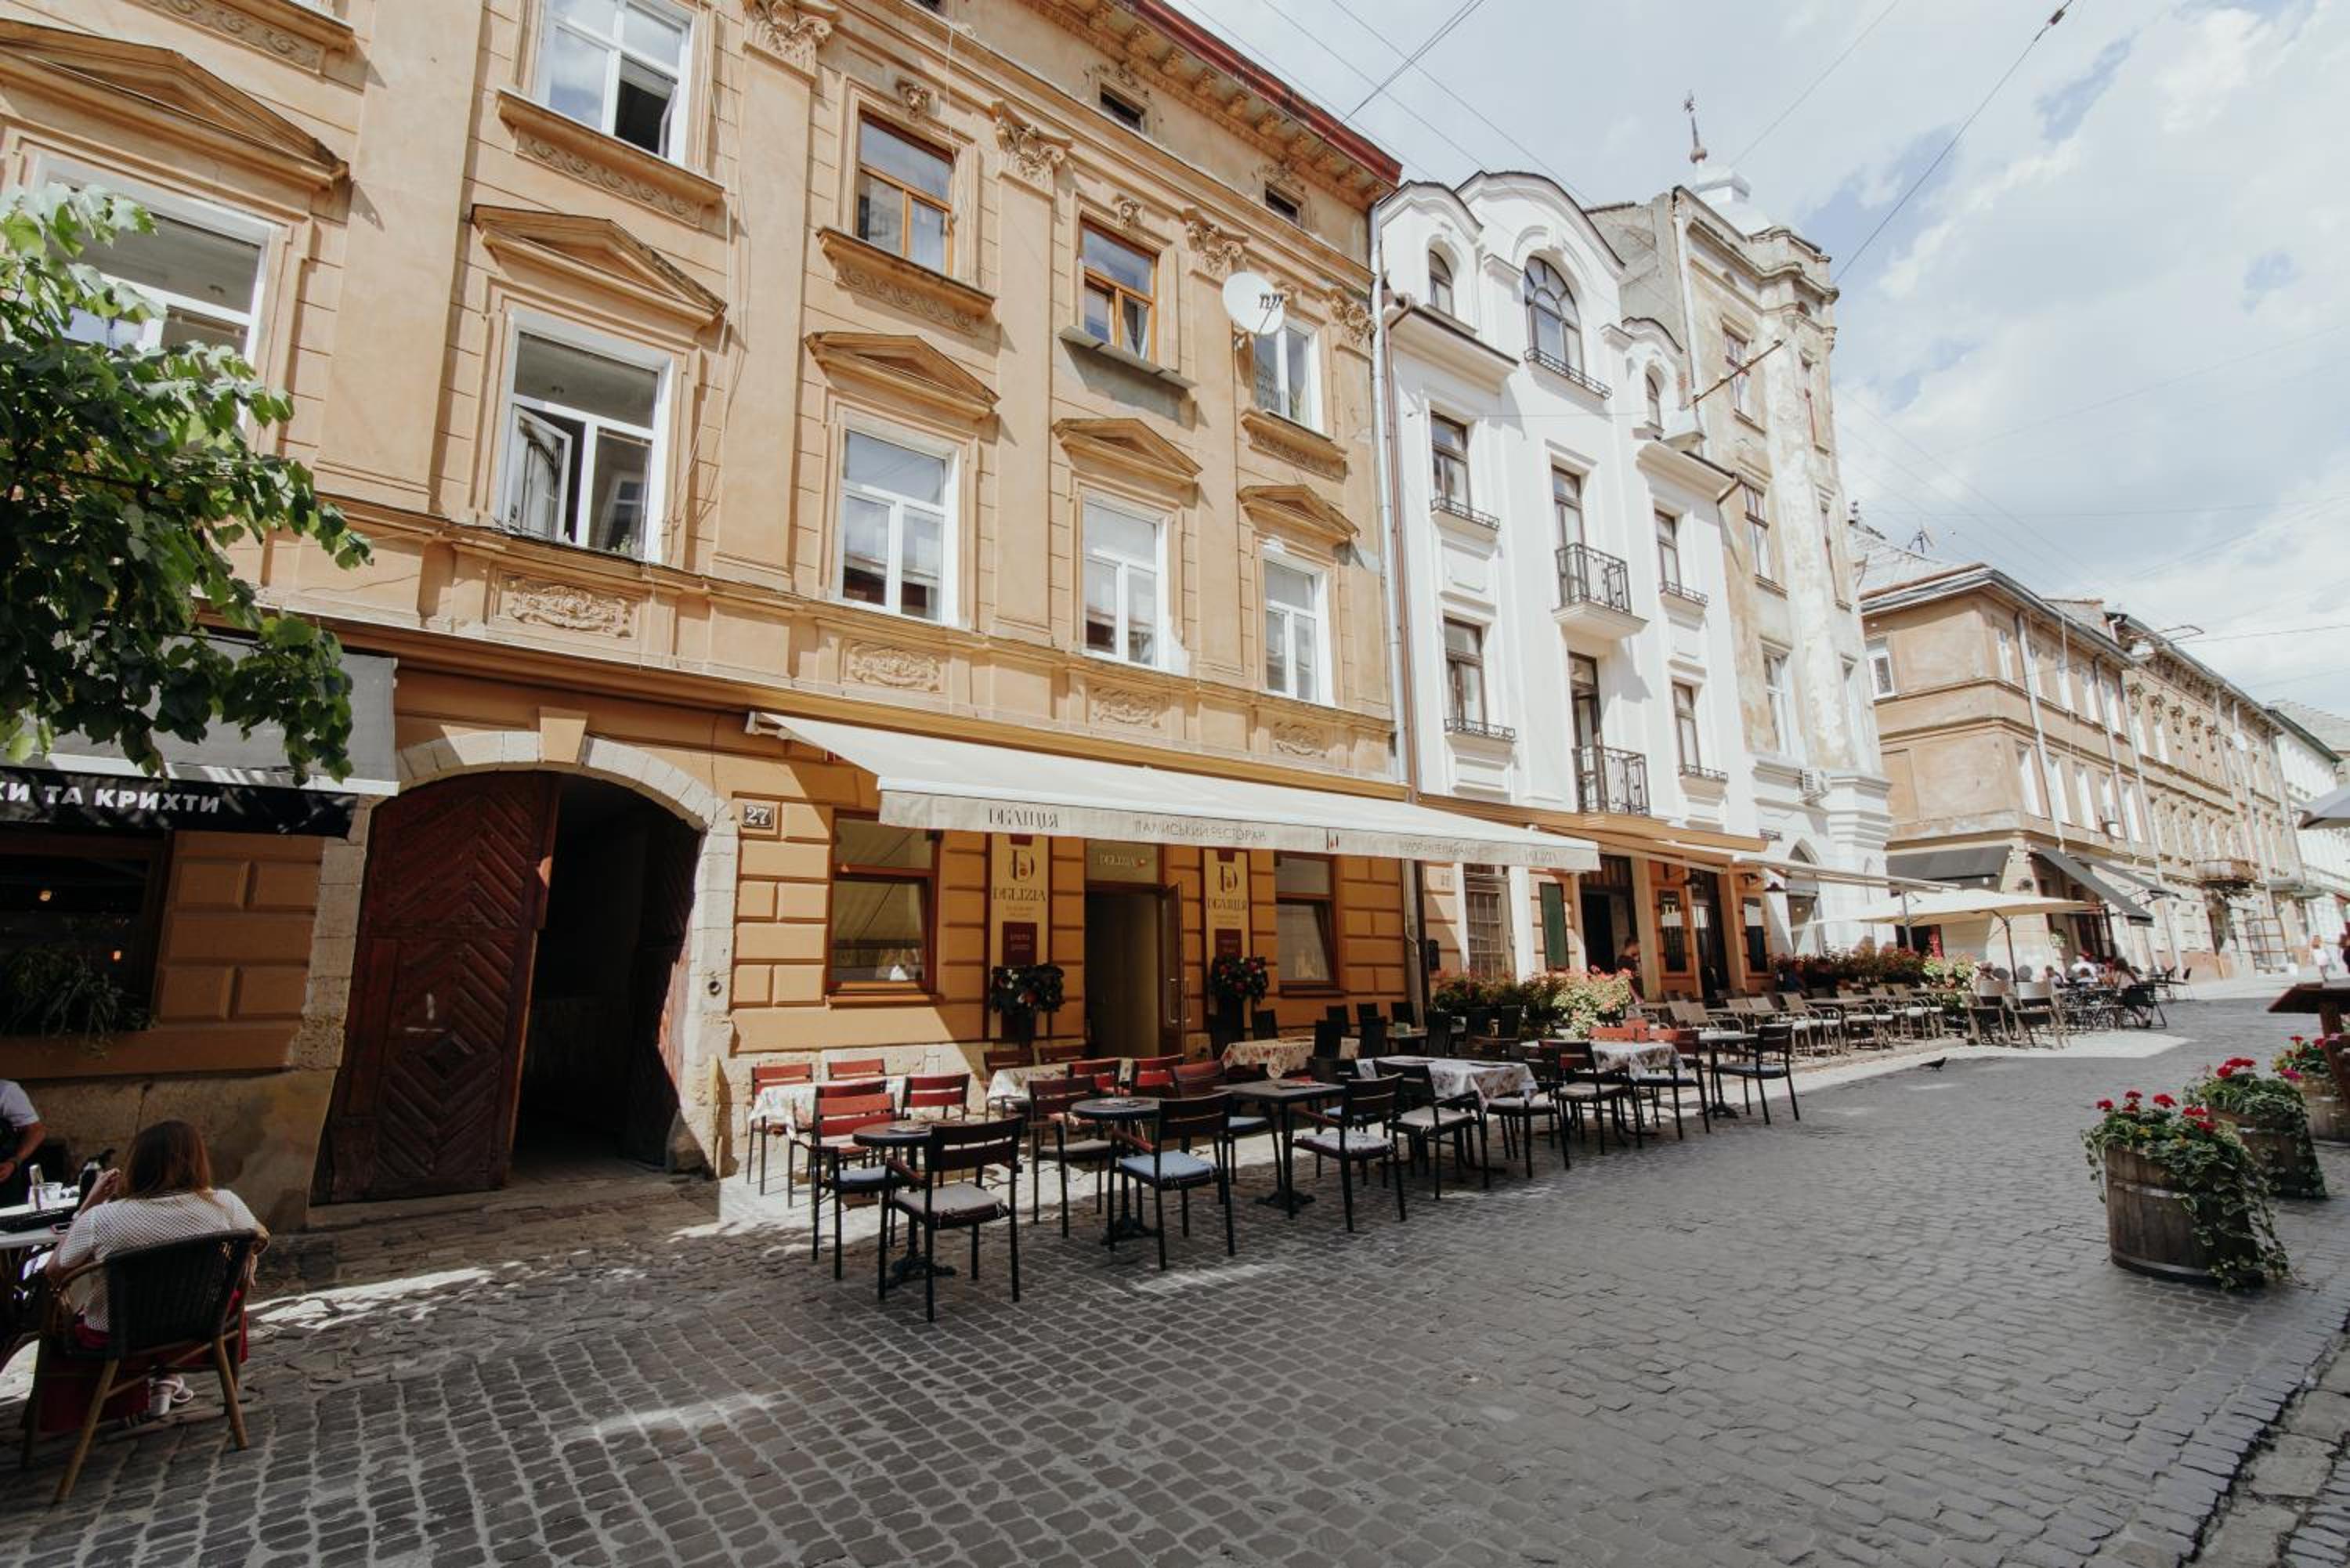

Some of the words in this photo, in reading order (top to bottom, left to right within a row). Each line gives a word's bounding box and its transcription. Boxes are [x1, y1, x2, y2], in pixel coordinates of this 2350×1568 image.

[0, 781, 30, 802] И
[45, 785, 84, 806] ТА
[95, 788, 221, 814] КРИХТИ
[745, 806, 770, 826] 27
[993, 887, 1047, 901] DELIZIA
